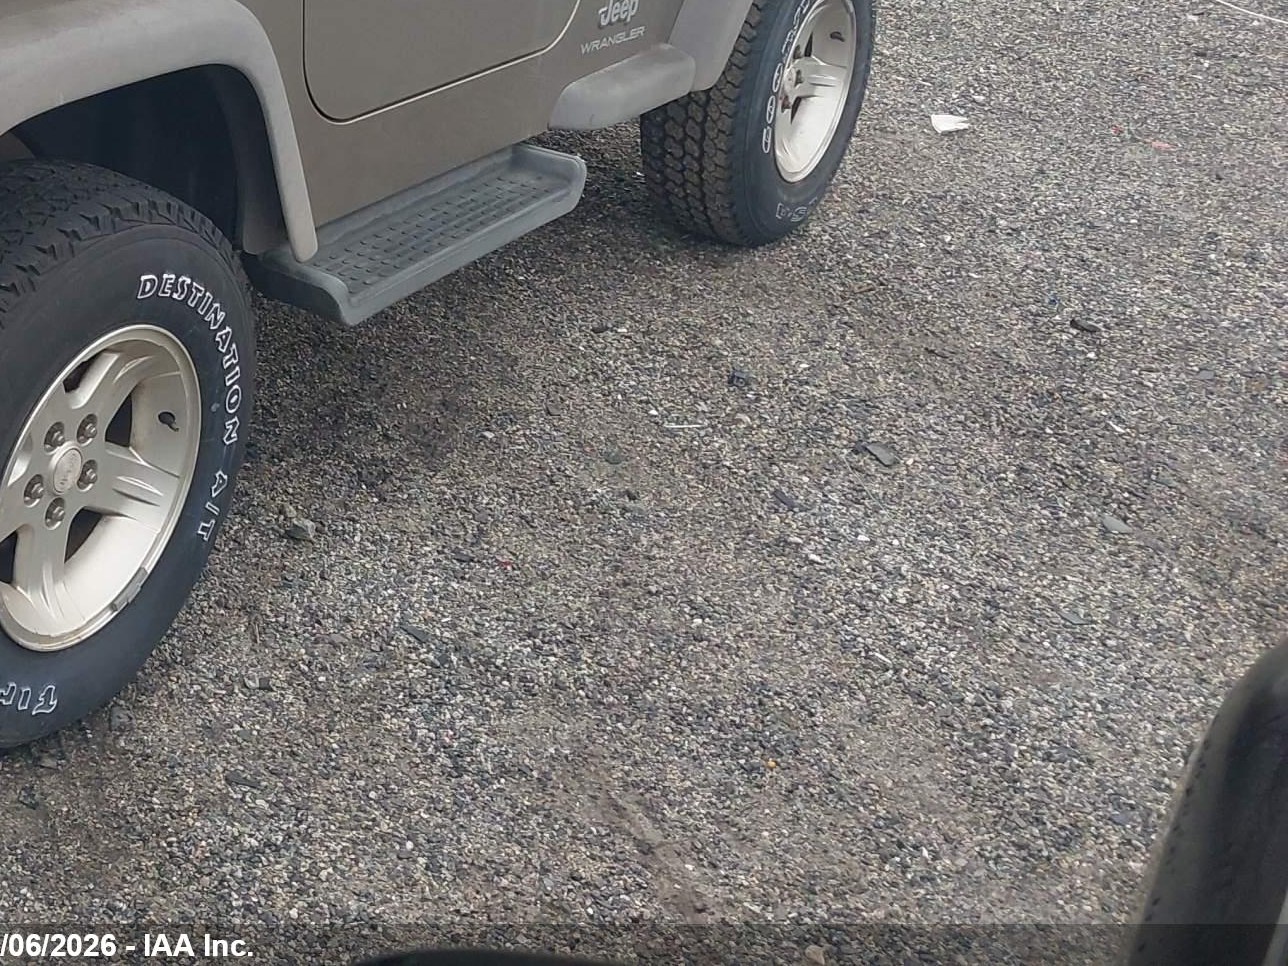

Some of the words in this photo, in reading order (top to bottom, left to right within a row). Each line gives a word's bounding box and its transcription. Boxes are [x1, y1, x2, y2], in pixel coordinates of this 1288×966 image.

[580, 25, 646, 55] WRANGLER
[136, 272, 244, 446] DESTINATION
[196, 470, 229, 542] A/T
